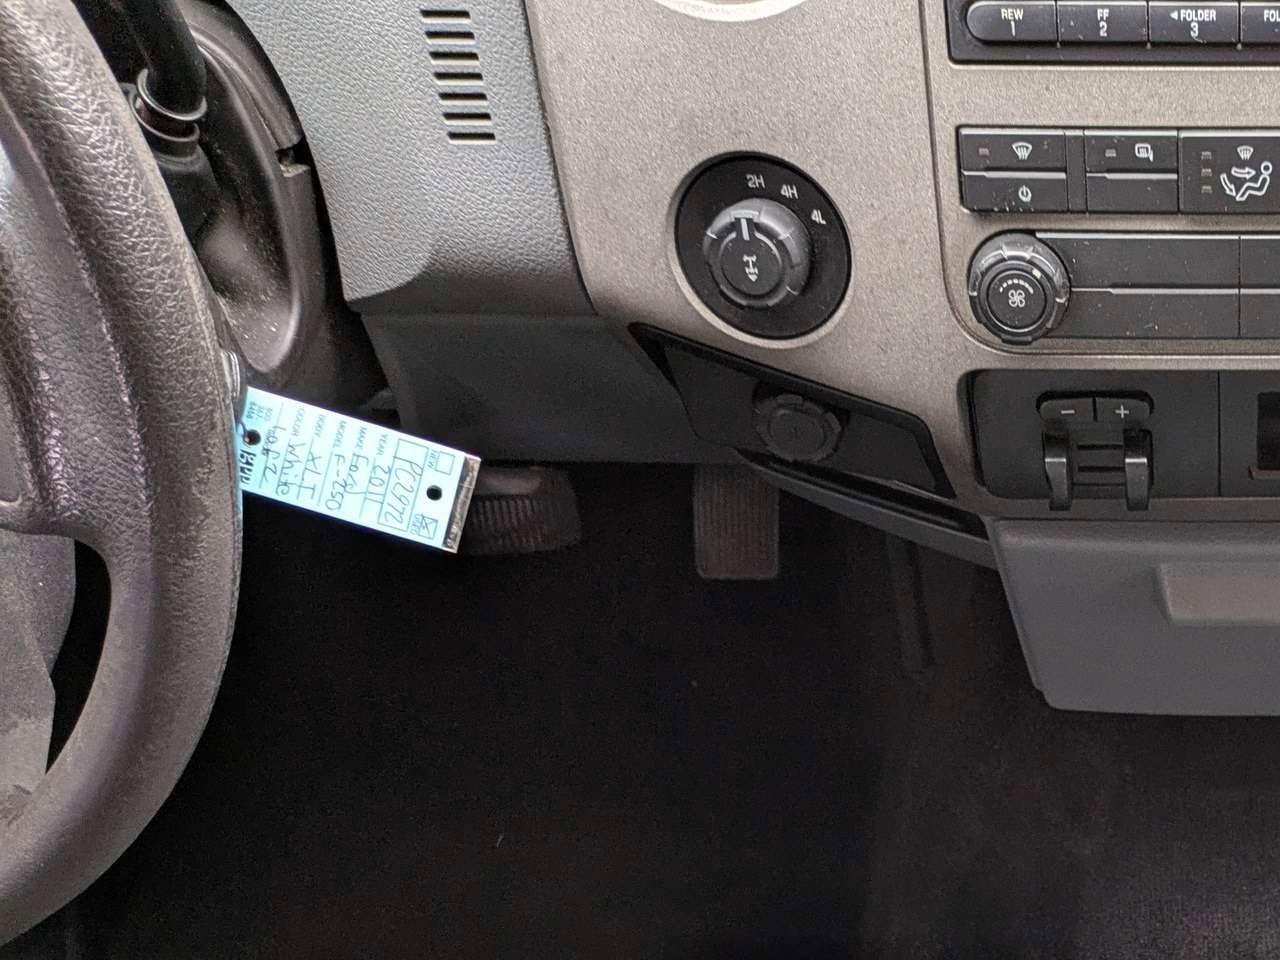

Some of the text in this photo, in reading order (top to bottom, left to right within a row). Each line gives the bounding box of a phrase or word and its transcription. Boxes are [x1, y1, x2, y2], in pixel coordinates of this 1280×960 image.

[1001, 8, 1024, 21] REW
[1097, 8, 1110, 21] FF
[1180, 9, 1217, 22] FOLDER
[1009, 21, 1016, 37] 1
[1099, 22, 1108, 37] 2
[1190, 22, 1199, 38] 3
[746, 174, 765, 188] 2H
[780, 184, 798, 199] 4H
[811, 209, 826, 224] 4L
[375, 432, 389, 456] YEAR
[325, 419, 348, 511] MODEL F-250
[299, 452, 321, 499] XLT
